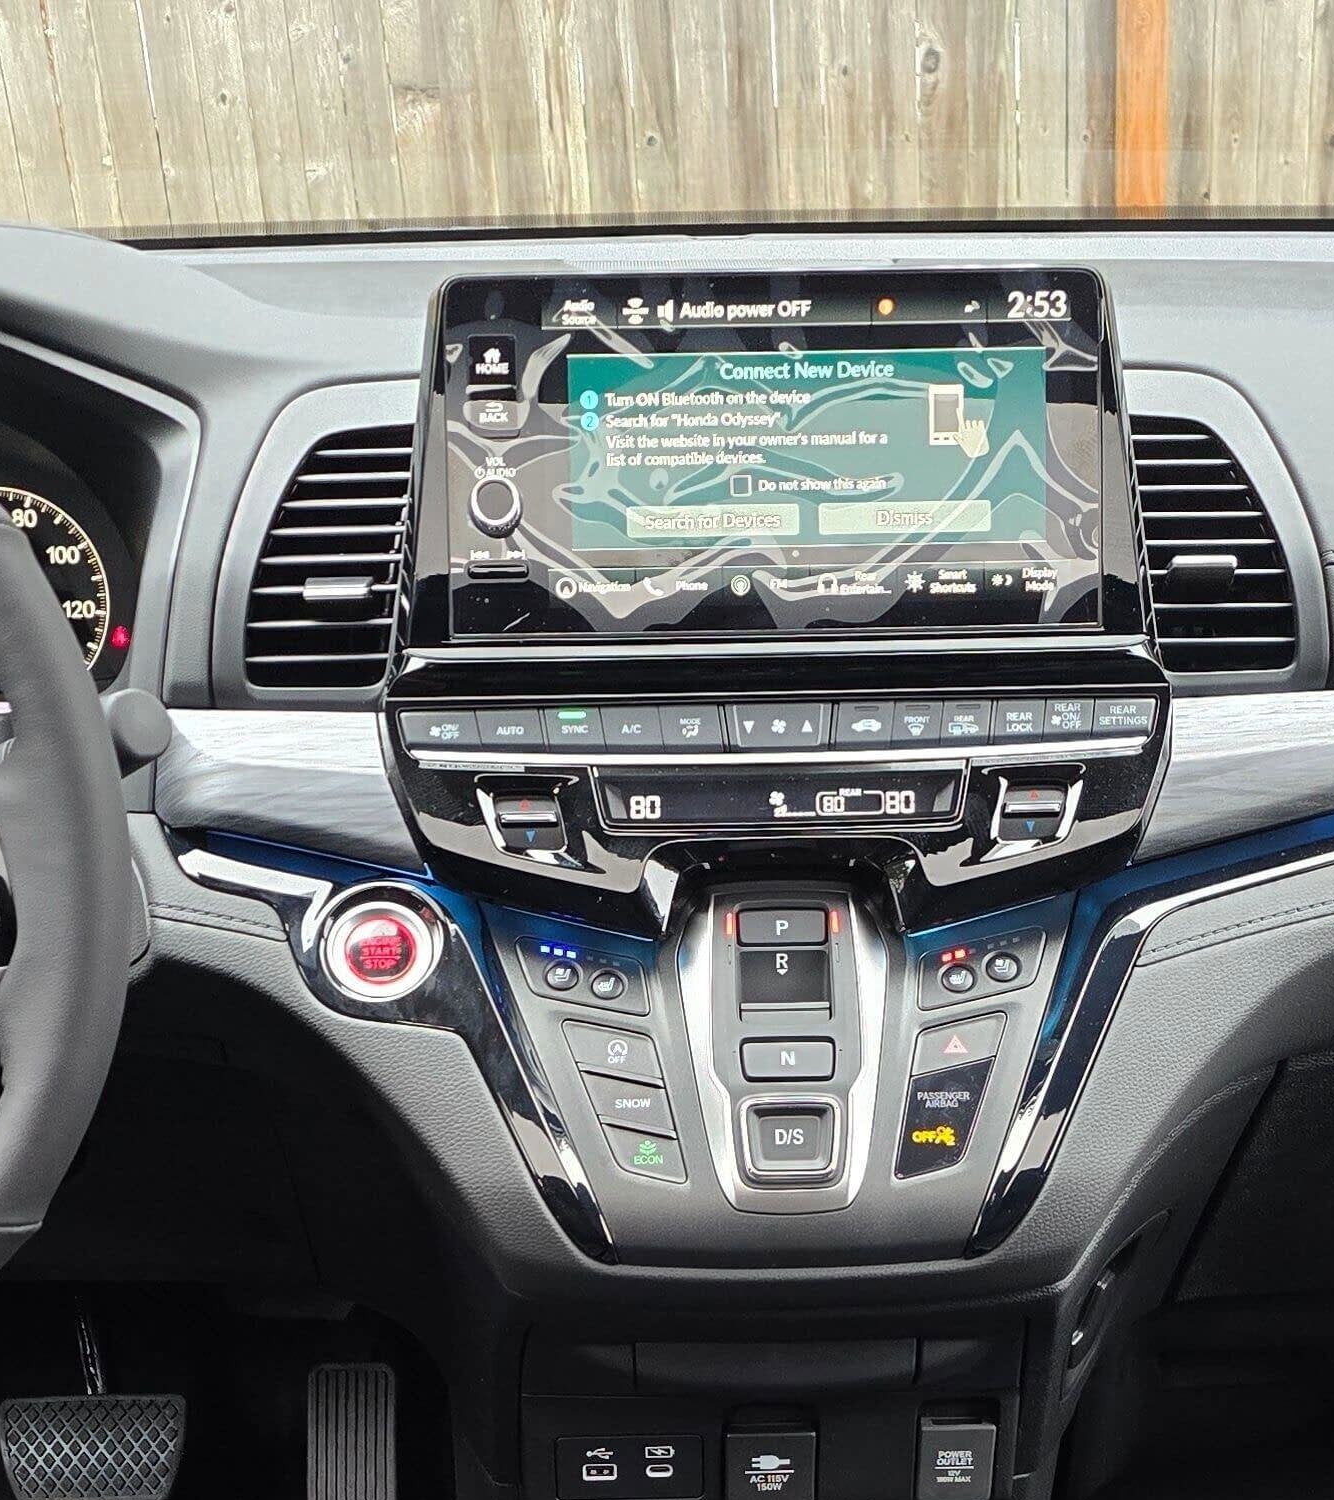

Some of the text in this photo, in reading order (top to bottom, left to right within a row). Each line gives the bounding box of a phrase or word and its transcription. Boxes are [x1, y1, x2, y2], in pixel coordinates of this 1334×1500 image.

[563, 299, 595, 312] Audio
[1007, 290, 1067, 318] 2:53
[680, 300, 812, 321] Audio power OFF
[475, 362, 510, 375] HOME
[719, 361, 895, 380] Connect New Device
[605, 390, 811, 408] Turn ON Bluetooth on the device
[479, 411, 508, 424] BACK
[605, 412, 781, 428] Search for "Honda Odyssey"
[605, 431, 888, 450] Visit the website in your owner's manual for a
[485, 457, 505, 468] VOL
[607, 451, 767, 466] list of compatible devices.
[485, 468, 516, 478] AUDIO
[759, 478, 887, 492] Do not show this again
[11, 508, 37, 528] 80
[645, 510, 781, 530] Search for Devices
[876, 509, 933, 526] Dismiss
[46, 546, 80, 564] 100
[854, 571, 877, 582] Rear
[938, 568, 967, 580] Smart
[1022, 568, 1057, 581] Display
[579, 581, 631, 594] Navigation
[675, 580, 709, 591] Phone
[769, 578, 789, 590] FM
[929, 582, 977, 594] Shortcuts
[1025, 581, 1054, 591] Mode
[63, 601, 95, 620] 120
[1055, 703, 1081, 712] REAR
[1109, 706, 1137, 714] REAR
[904, 716, 930, 724] FRONT
[1006, 712, 1033, 722] REAR
[1062, 712, 1081, 722] ON/
[1099, 716, 1147, 726] SETTINGS
[497, 726, 525, 735] AUTO
[561, 725, 589, 734] SYNC
[621, 724, 641, 734] A/C
[1006, 724, 1033, 732] LOCK
[1062, 721, 1082, 730] OFF
[441, 732, 459, 740] OFF
[629, 794, 662, 820] 80
[823, 796, 845, 812] 80
[885, 790, 915, 814] 80
[775, 920, 789, 936] P
[361, 947, 398, 956] START
[363, 960, 397, 968] STOP
[776, 953, 789, 969] R
[607, 1056, 627, 1064] OFF
[780, 1050, 795, 1066] N
[917, 1092, 970, 1100] PASSENGER
[615, 1098, 651, 1108] SNOW
[925, 1100, 959, 1108] AIRBAG
[775, 1128, 804, 1144] D/S
[633, 1155, 663, 1164] ECON
[939, 1450, 972, 1458] POWER
[750, 1474, 789, 1483] AC 115V
[757, 1482, 783, 1491] 150W
